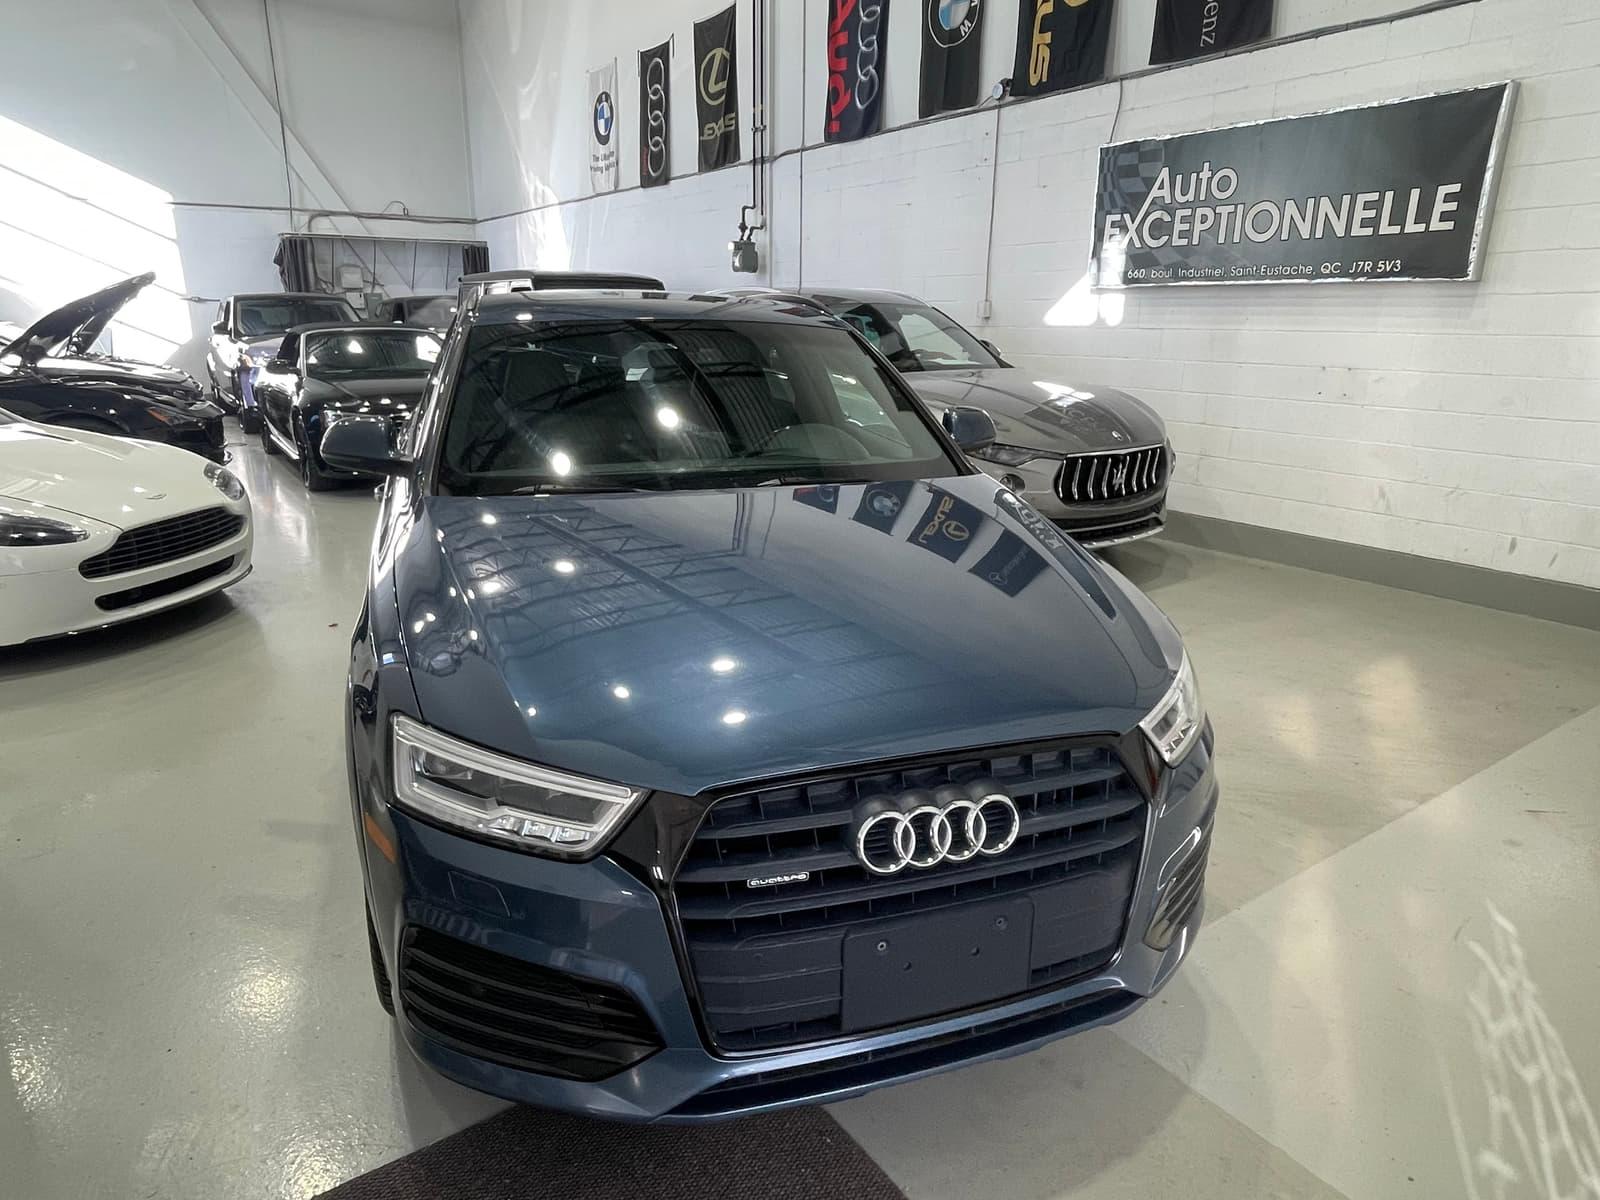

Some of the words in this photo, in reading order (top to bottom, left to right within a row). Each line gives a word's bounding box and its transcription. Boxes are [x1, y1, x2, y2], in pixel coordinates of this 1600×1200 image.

[1200, 0, 1219, 47] enz
[1149, 161, 1238, 205] Auto
[1102, 183, 1462, 248] EXCEPTIONNELLE
[1320, 262, 1342, 274] QC
[1349, 261, 1374, 273] J7R
[1376, 259, 1401, 273] 5V3
